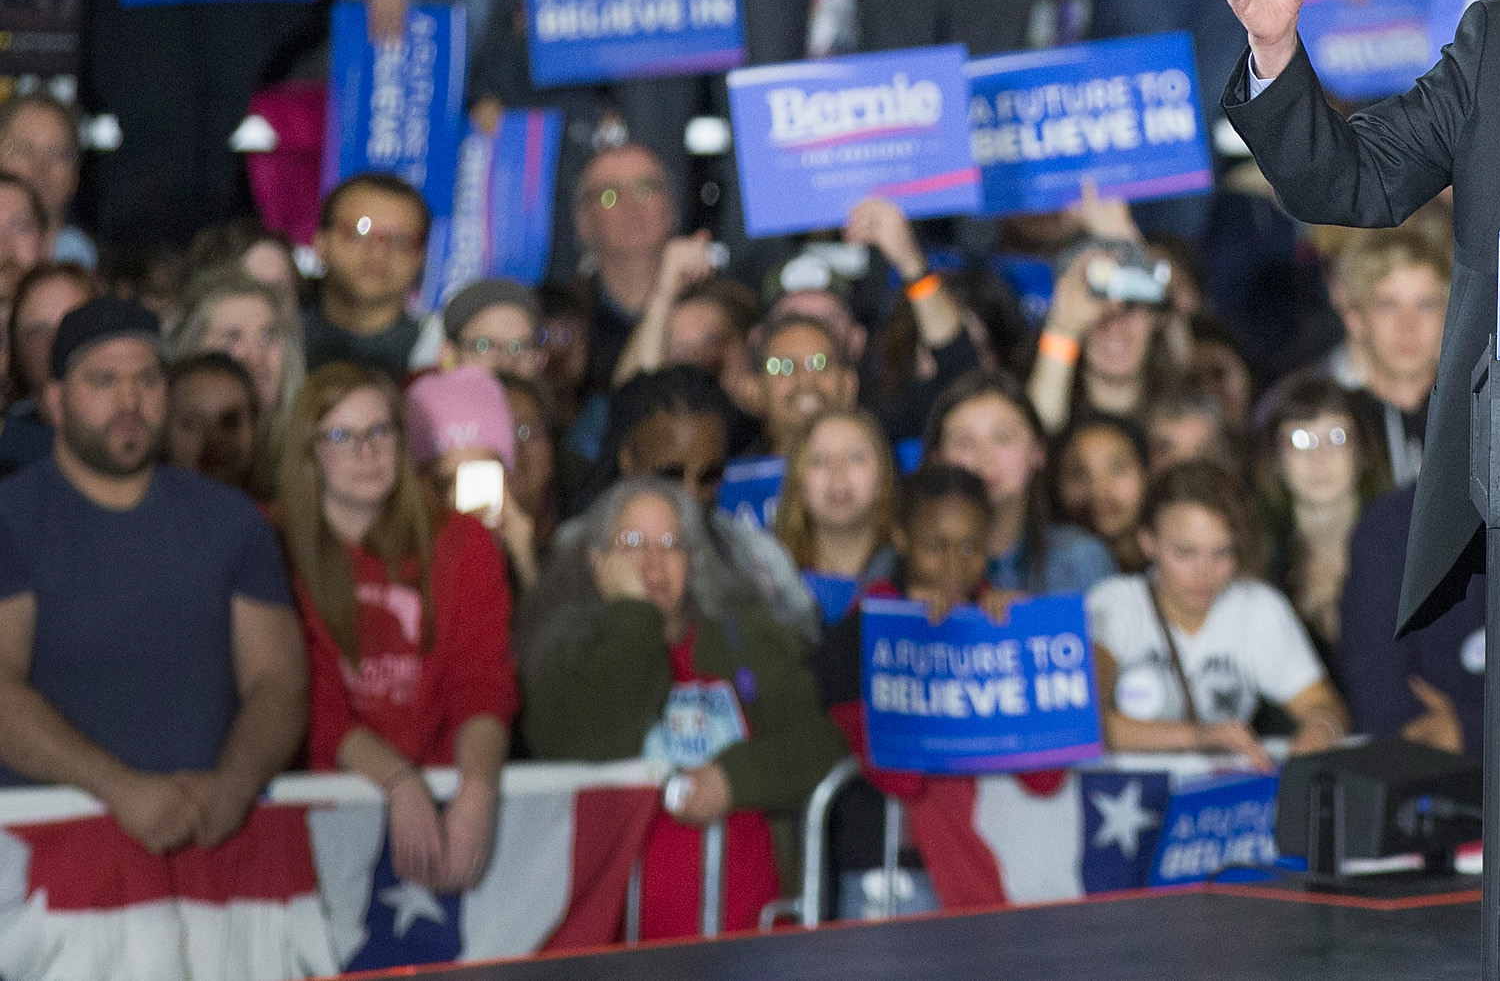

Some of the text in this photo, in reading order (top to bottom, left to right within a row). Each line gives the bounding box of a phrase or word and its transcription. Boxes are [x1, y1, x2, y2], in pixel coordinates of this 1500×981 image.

[767, 73, 944, 143] Bernie
[996, 75, 1130, 121] FUTURE
[1134, 69, 1192, 104] TO
[970, 111, 1140, 167] BELIEVE
[1143, 104, 1196, 145] IN
[871, 633, 1086, 676] A FUTURE TO
[871, 672, 1088, 718] BELIEVE IN
[1159, 832, 1278, 879] BELIEV
